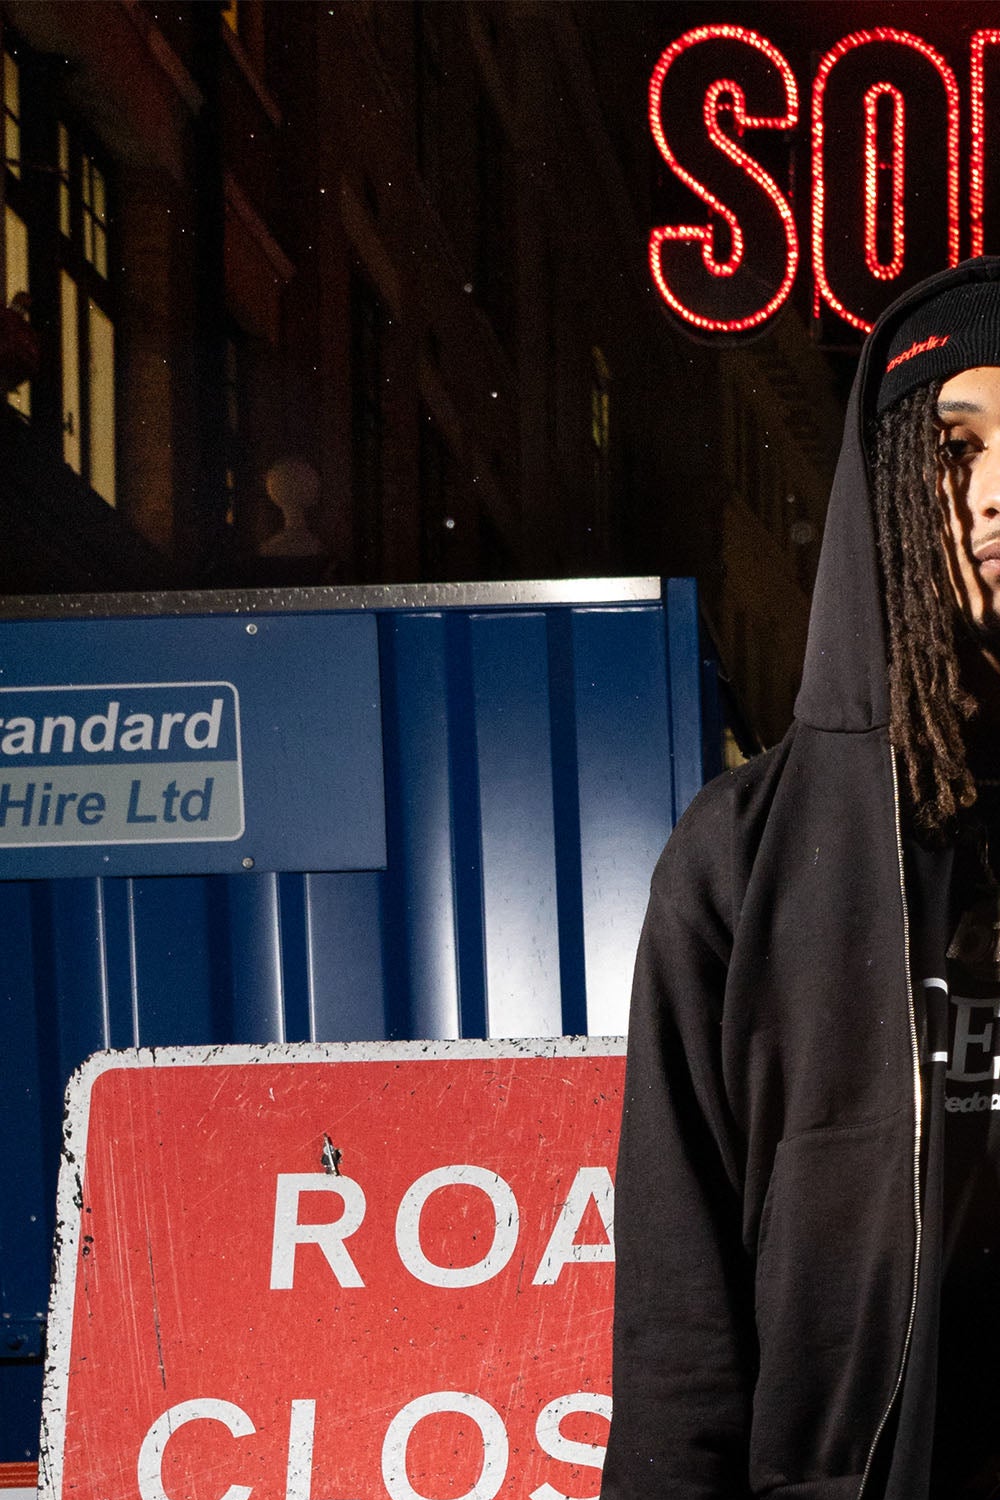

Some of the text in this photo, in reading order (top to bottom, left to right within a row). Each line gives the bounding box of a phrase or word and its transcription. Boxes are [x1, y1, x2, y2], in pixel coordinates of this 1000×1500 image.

[0, 699, 224, 755] andard
[0, 777, 215, 828] Hire Ltd
[269, 1164, 616, 1290] ROA
